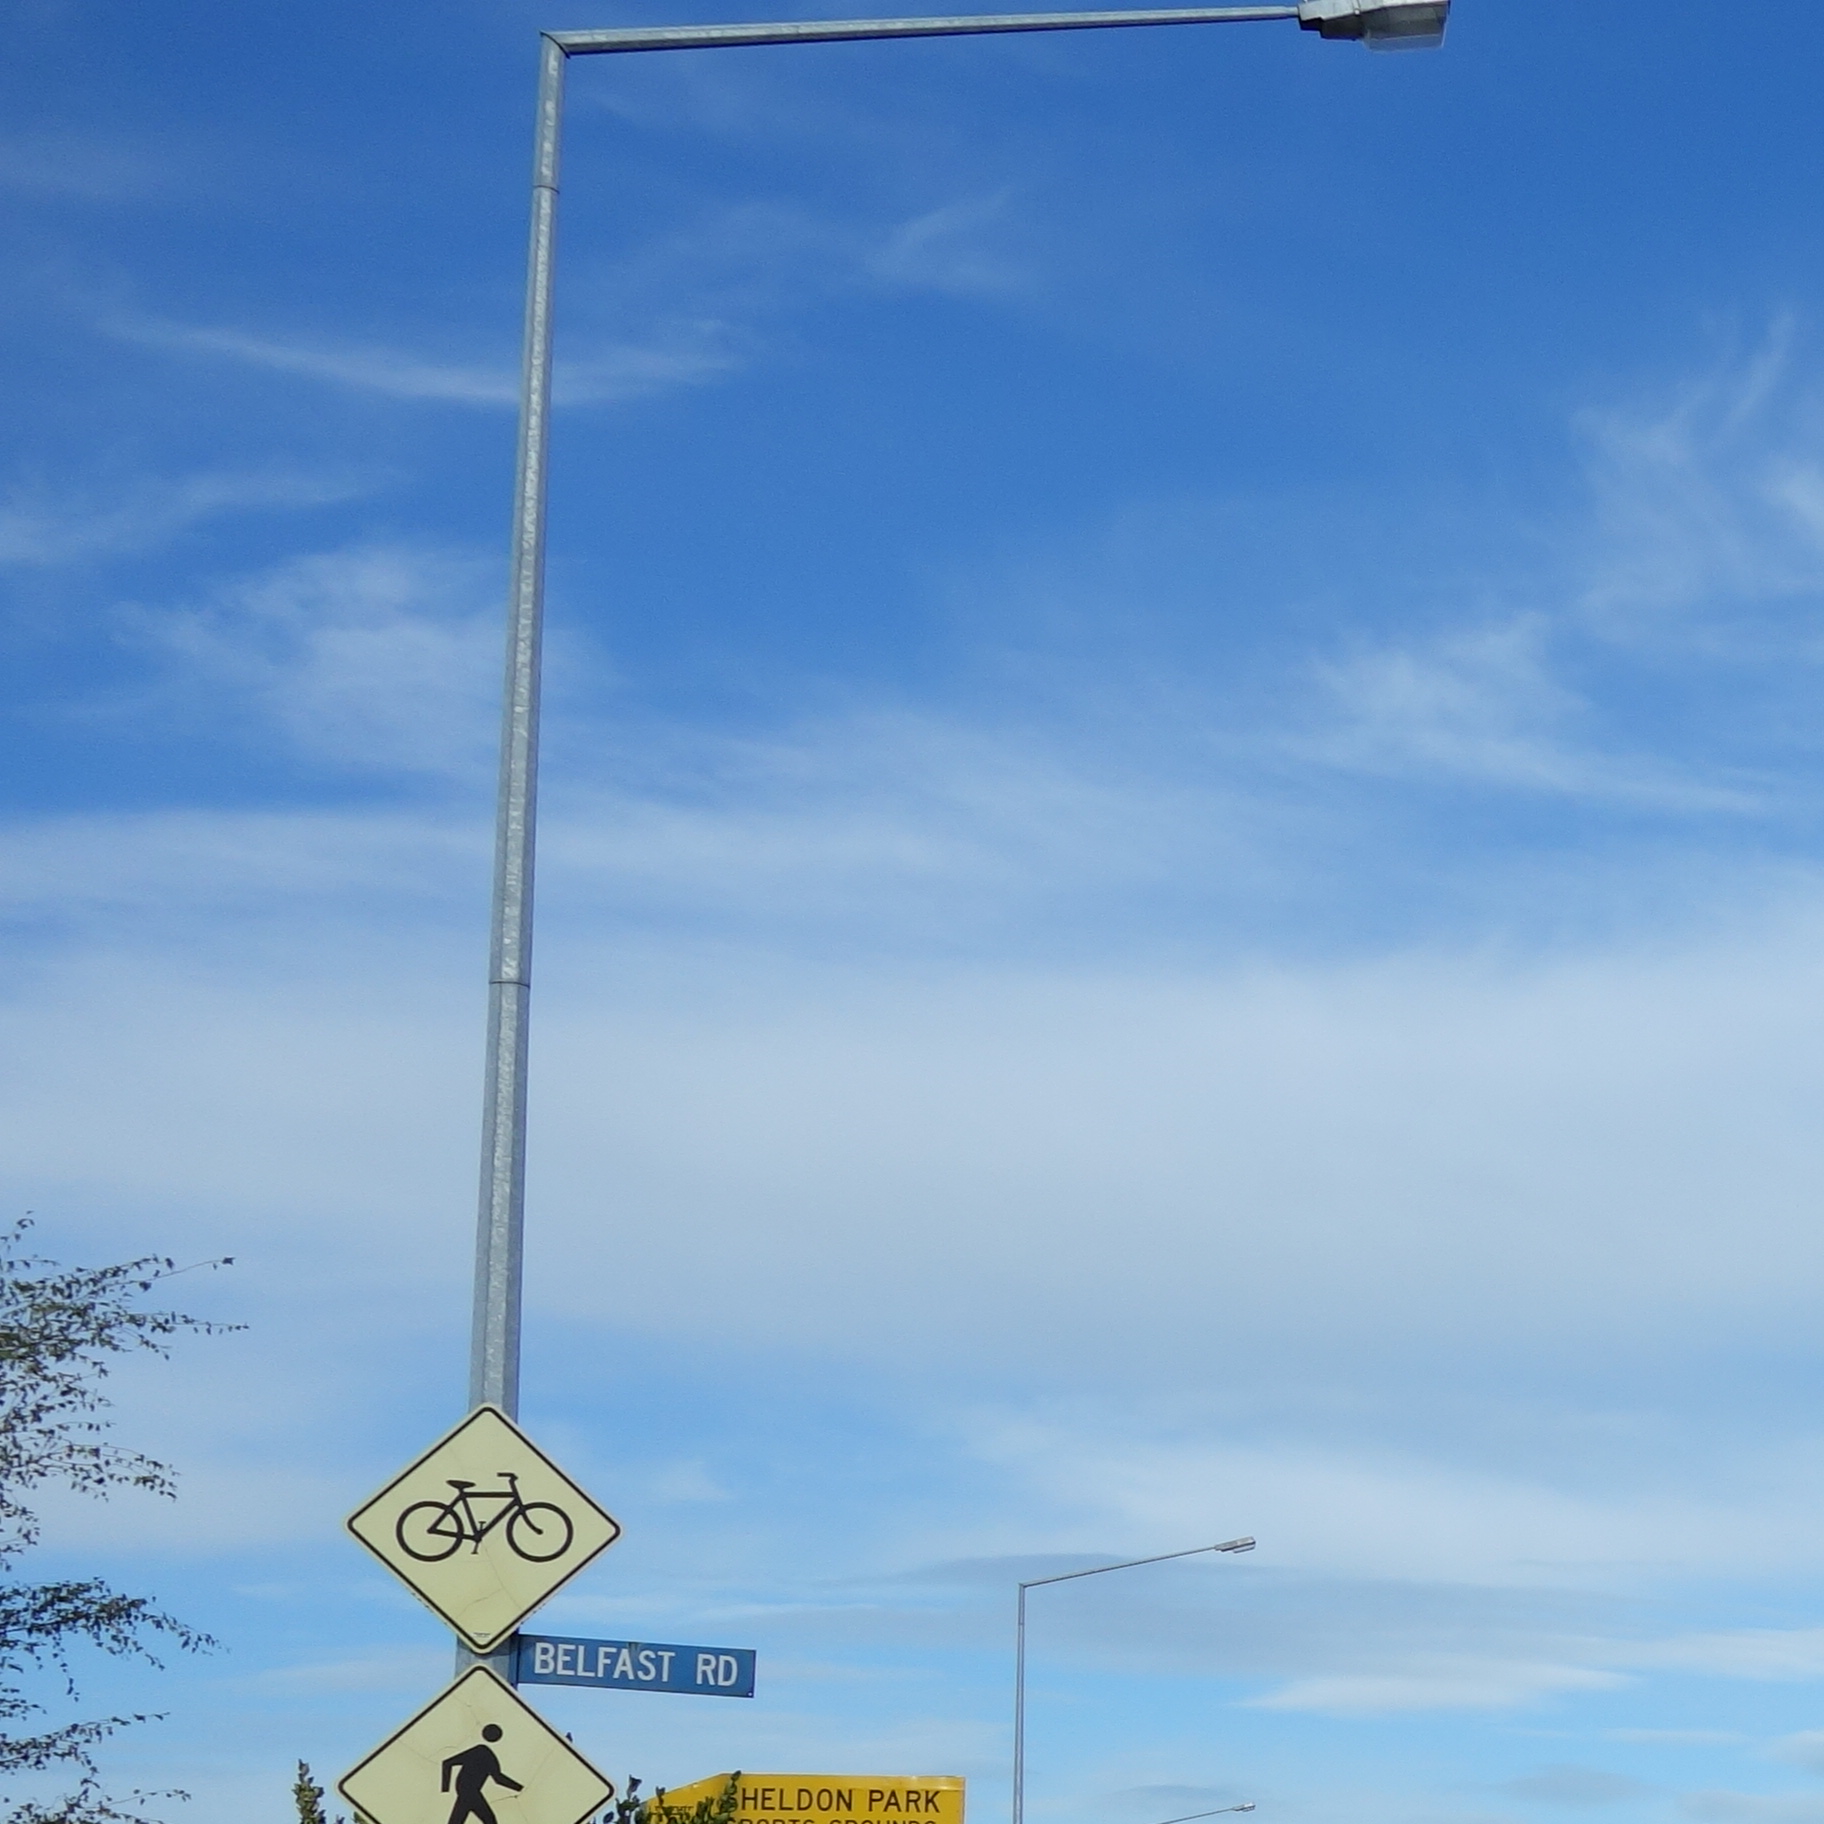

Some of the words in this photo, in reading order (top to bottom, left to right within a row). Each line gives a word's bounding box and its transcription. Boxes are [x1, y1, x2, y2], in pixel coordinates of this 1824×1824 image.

[534, 1641, 676, 1682] BELFAST
[696, 1653, 738, 1687] RD
[740, 1787, 852, 1812] HELDON
[868, 1790, 941, 1813] PARK
